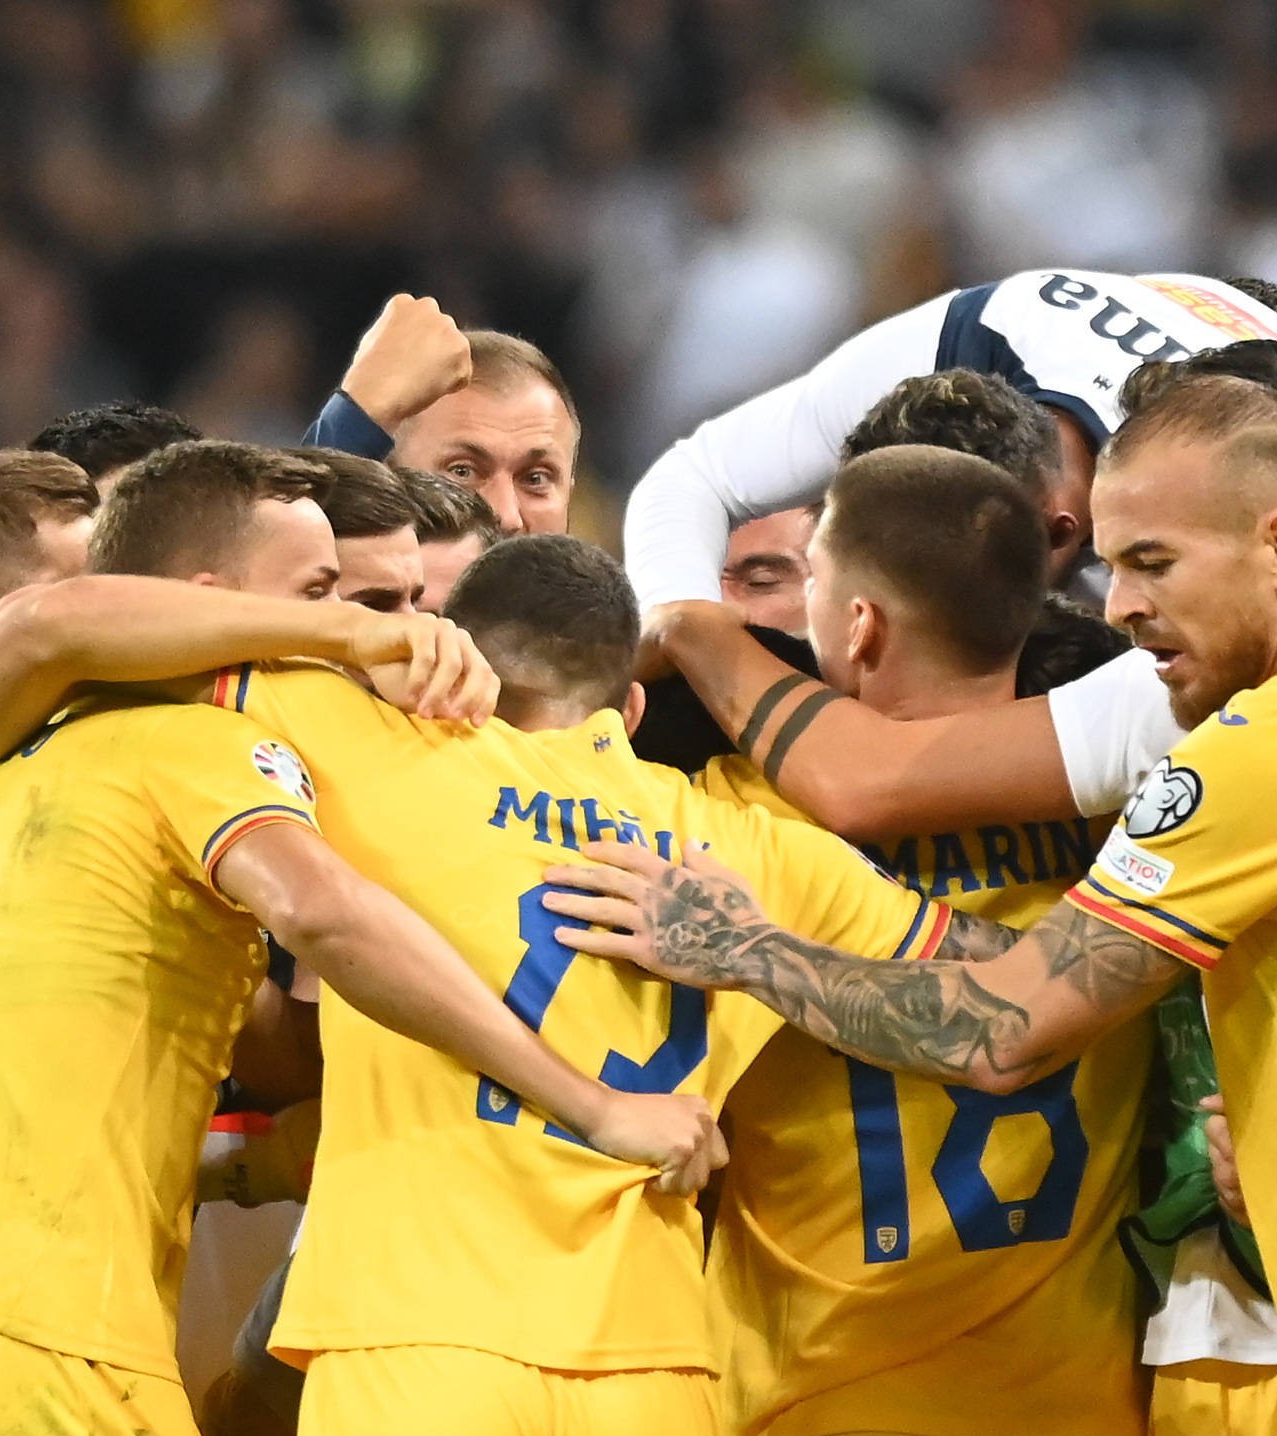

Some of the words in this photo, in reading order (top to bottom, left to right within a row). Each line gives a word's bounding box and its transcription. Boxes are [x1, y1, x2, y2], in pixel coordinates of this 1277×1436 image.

[1039, 273, 1192, 363] ma
[861, 816, 1098, 898] MARIN
[845, 1055, 1090, 1265] 18
